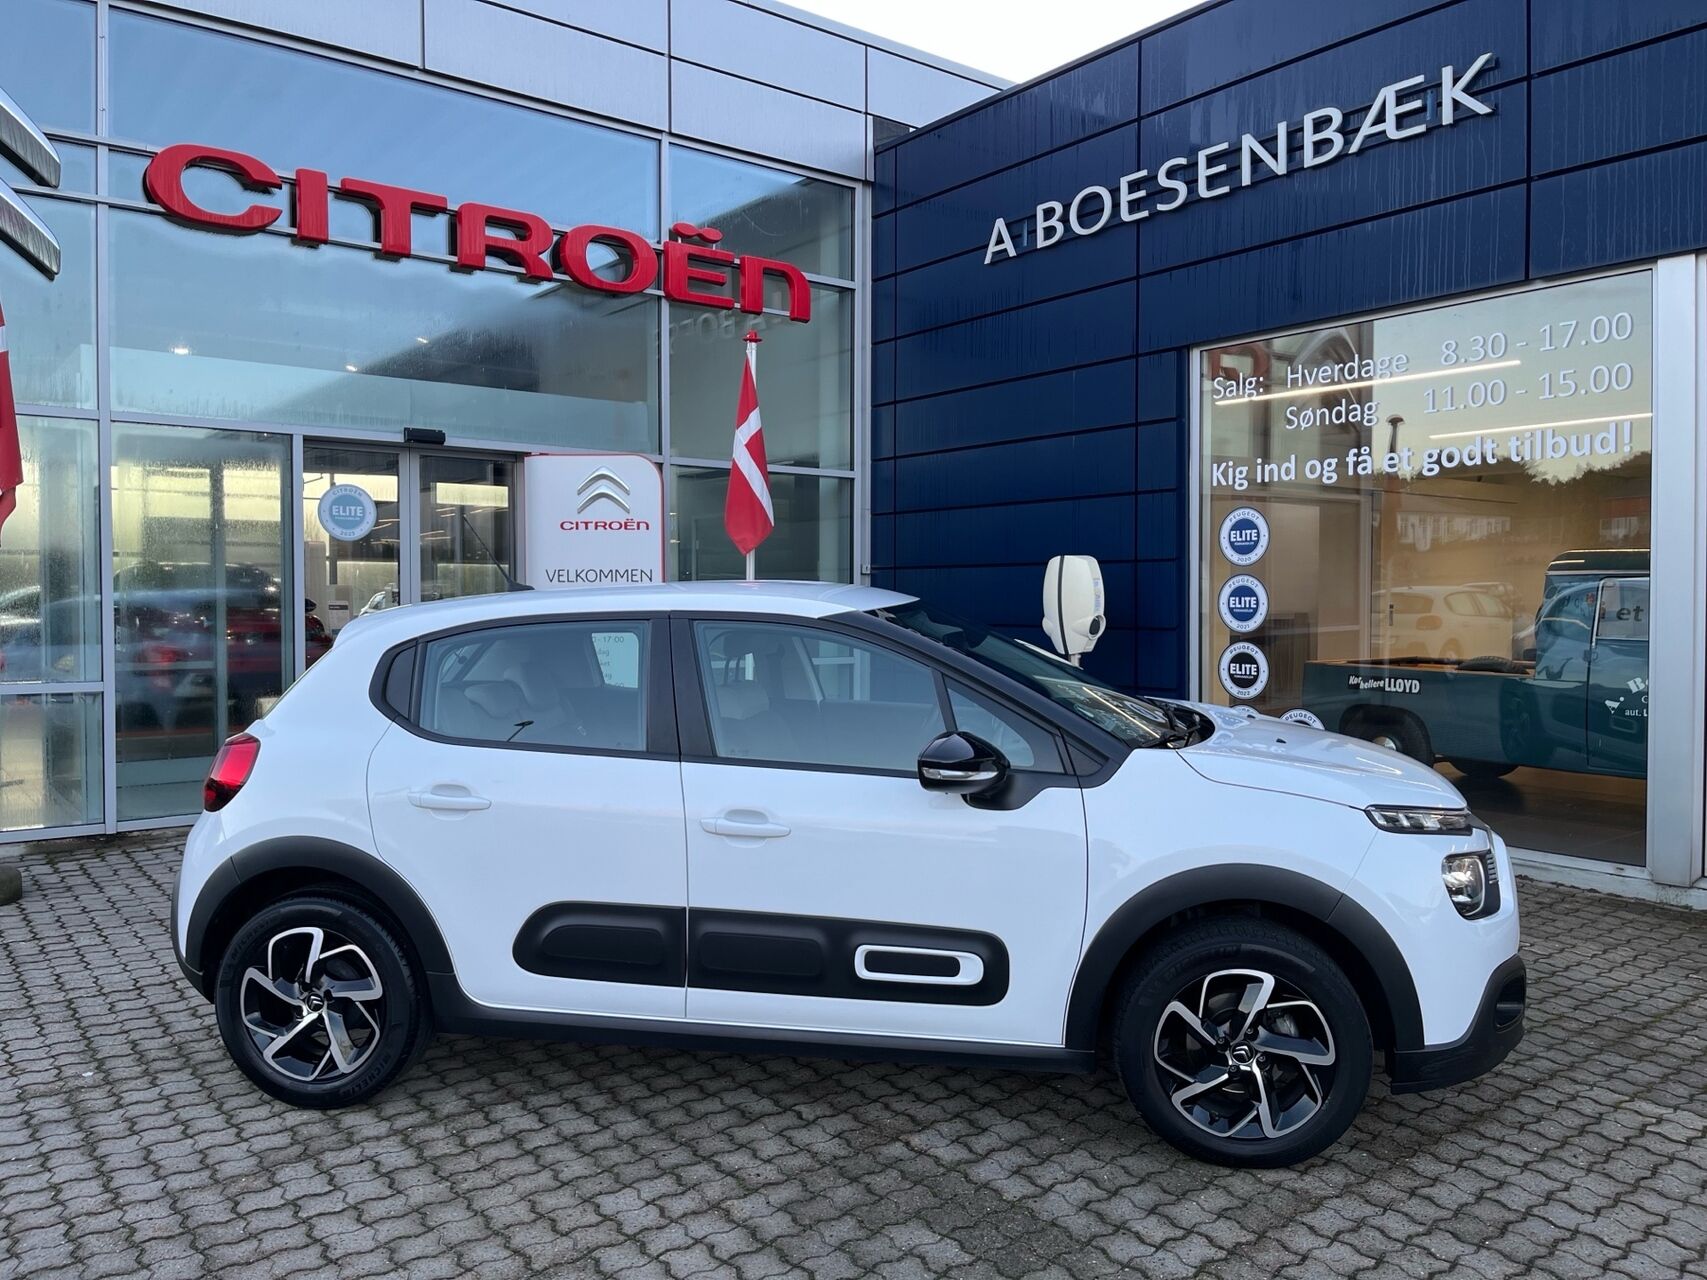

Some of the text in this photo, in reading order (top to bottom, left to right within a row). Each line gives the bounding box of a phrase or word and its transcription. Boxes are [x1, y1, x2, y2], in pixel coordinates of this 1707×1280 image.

[983, 52, 1496, 265] A BOESENBÆK
[1212, 372, 1264, 399] Salg:
[1287, 353, 1409, 388] Hverdage
[1441, 331, 1508, 366] 8.30
[1539, 312, 1634, 351] 17.00
[1285, 398, 1380, 431] Søndag
[1423, 379, 1508, 414] 11.00
[1538, 362, 1634, 400] 15.00
[1211, 420, 1633, 491] Kig ind og få et godt tilbud!
[332, 505, 364, 517] ELITE
[1229, 510, 1260, 523] PEUGEOT
[1230, 530, 1258, 542] ELITE
[545, 569, 653, 583] VELKOMMEN
[1227, 577, 1259, 589] PEUGEOT
[1229, 596, 1257, 608] ELITE
[1229, 644, 1259, 655] PEUGEOT
[1229, 663, 1258, 675] ELITE
[1385, 678, 1420, 693] LLOYD
[1284, 712, 1317, 725] PEUGEOT
